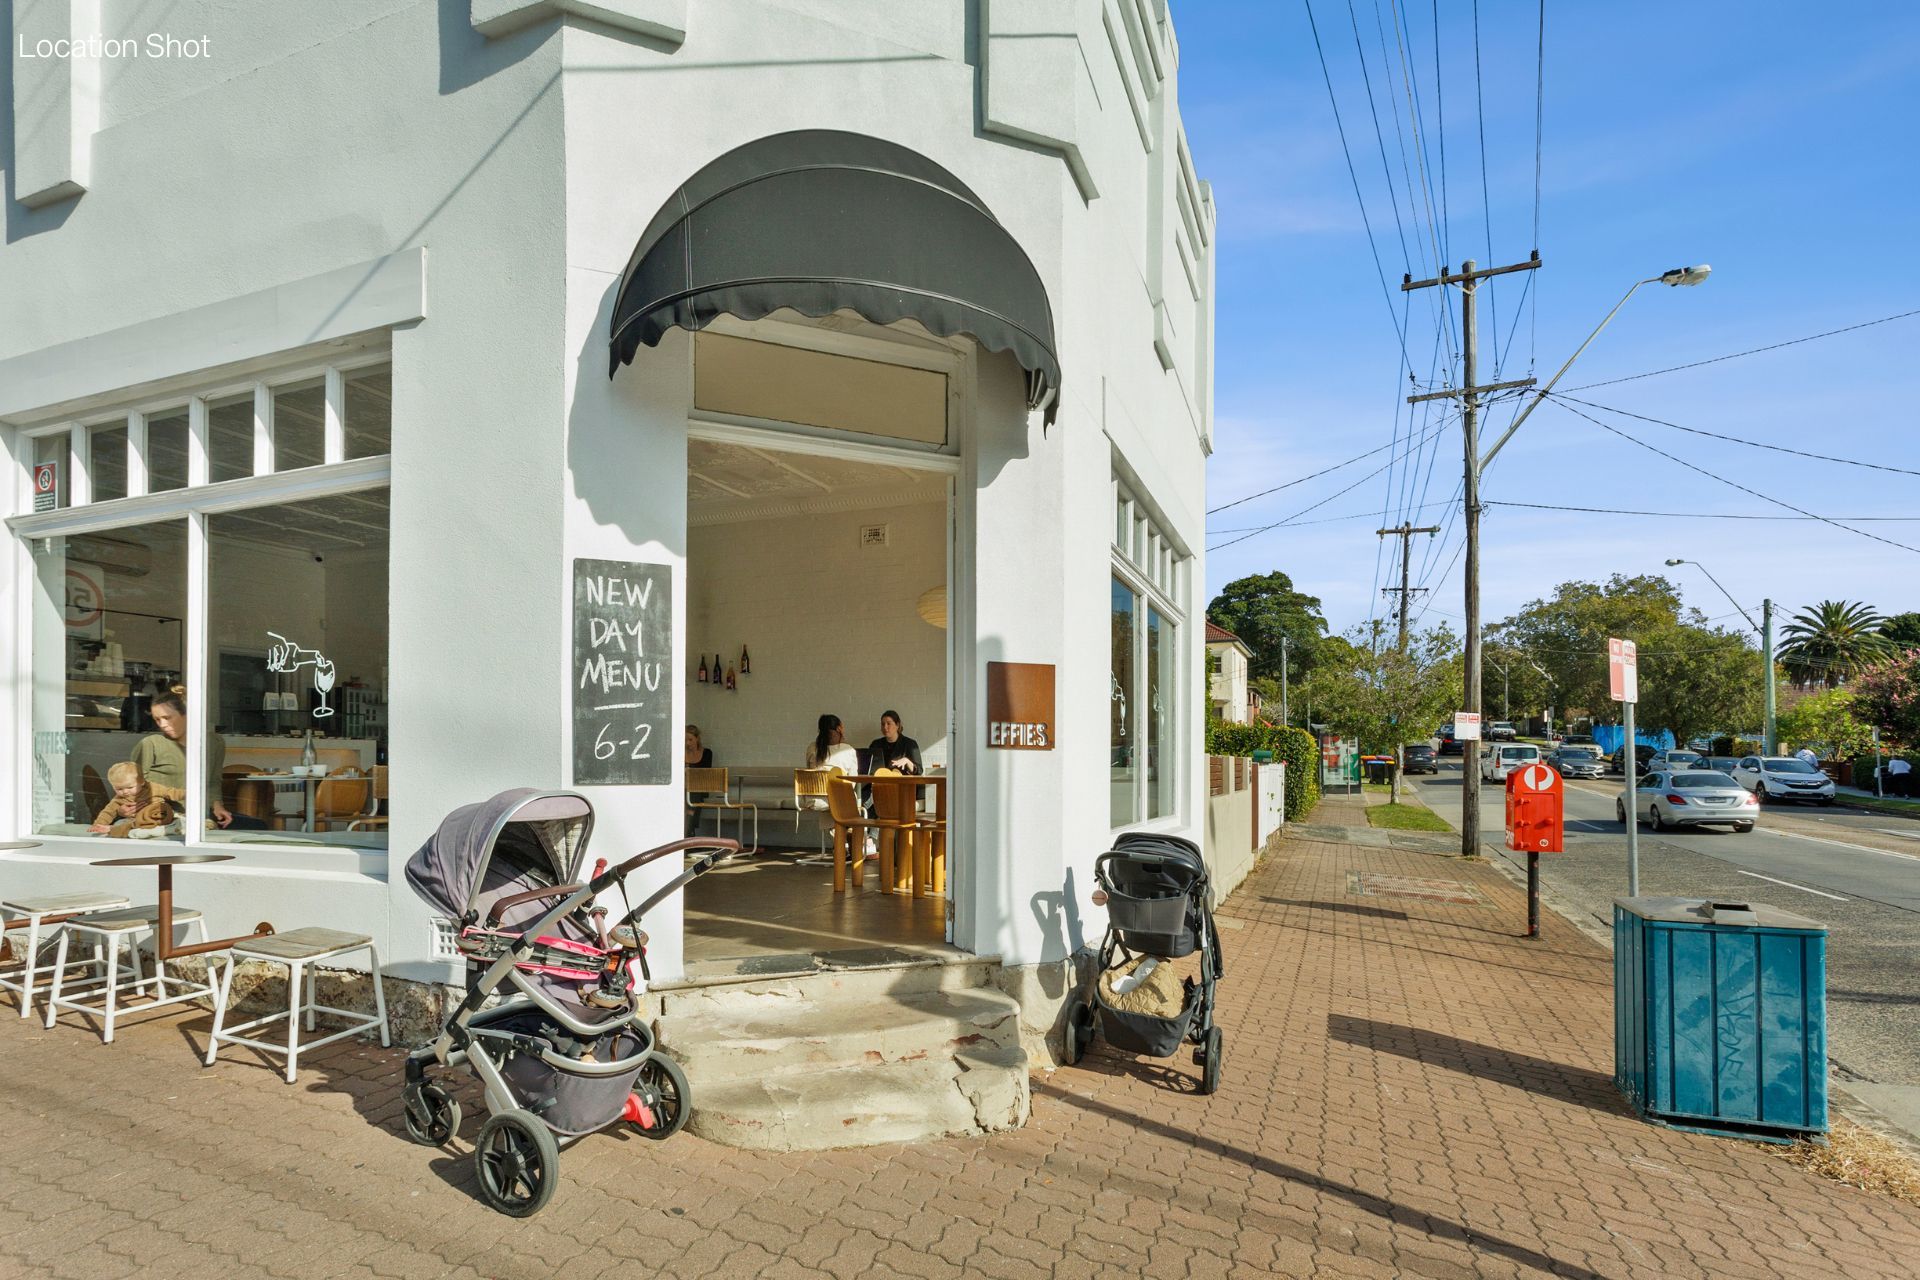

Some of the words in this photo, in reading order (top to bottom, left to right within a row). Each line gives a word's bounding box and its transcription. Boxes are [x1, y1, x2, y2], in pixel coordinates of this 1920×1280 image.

[586, 576, 652, 610] NEW
[590, 618, 643, 657] DAY
[580, 653, 661, 693] MENU
[594, 723, 652, 760] 6-2
[990, 721, 1048, 747] EFFIES
